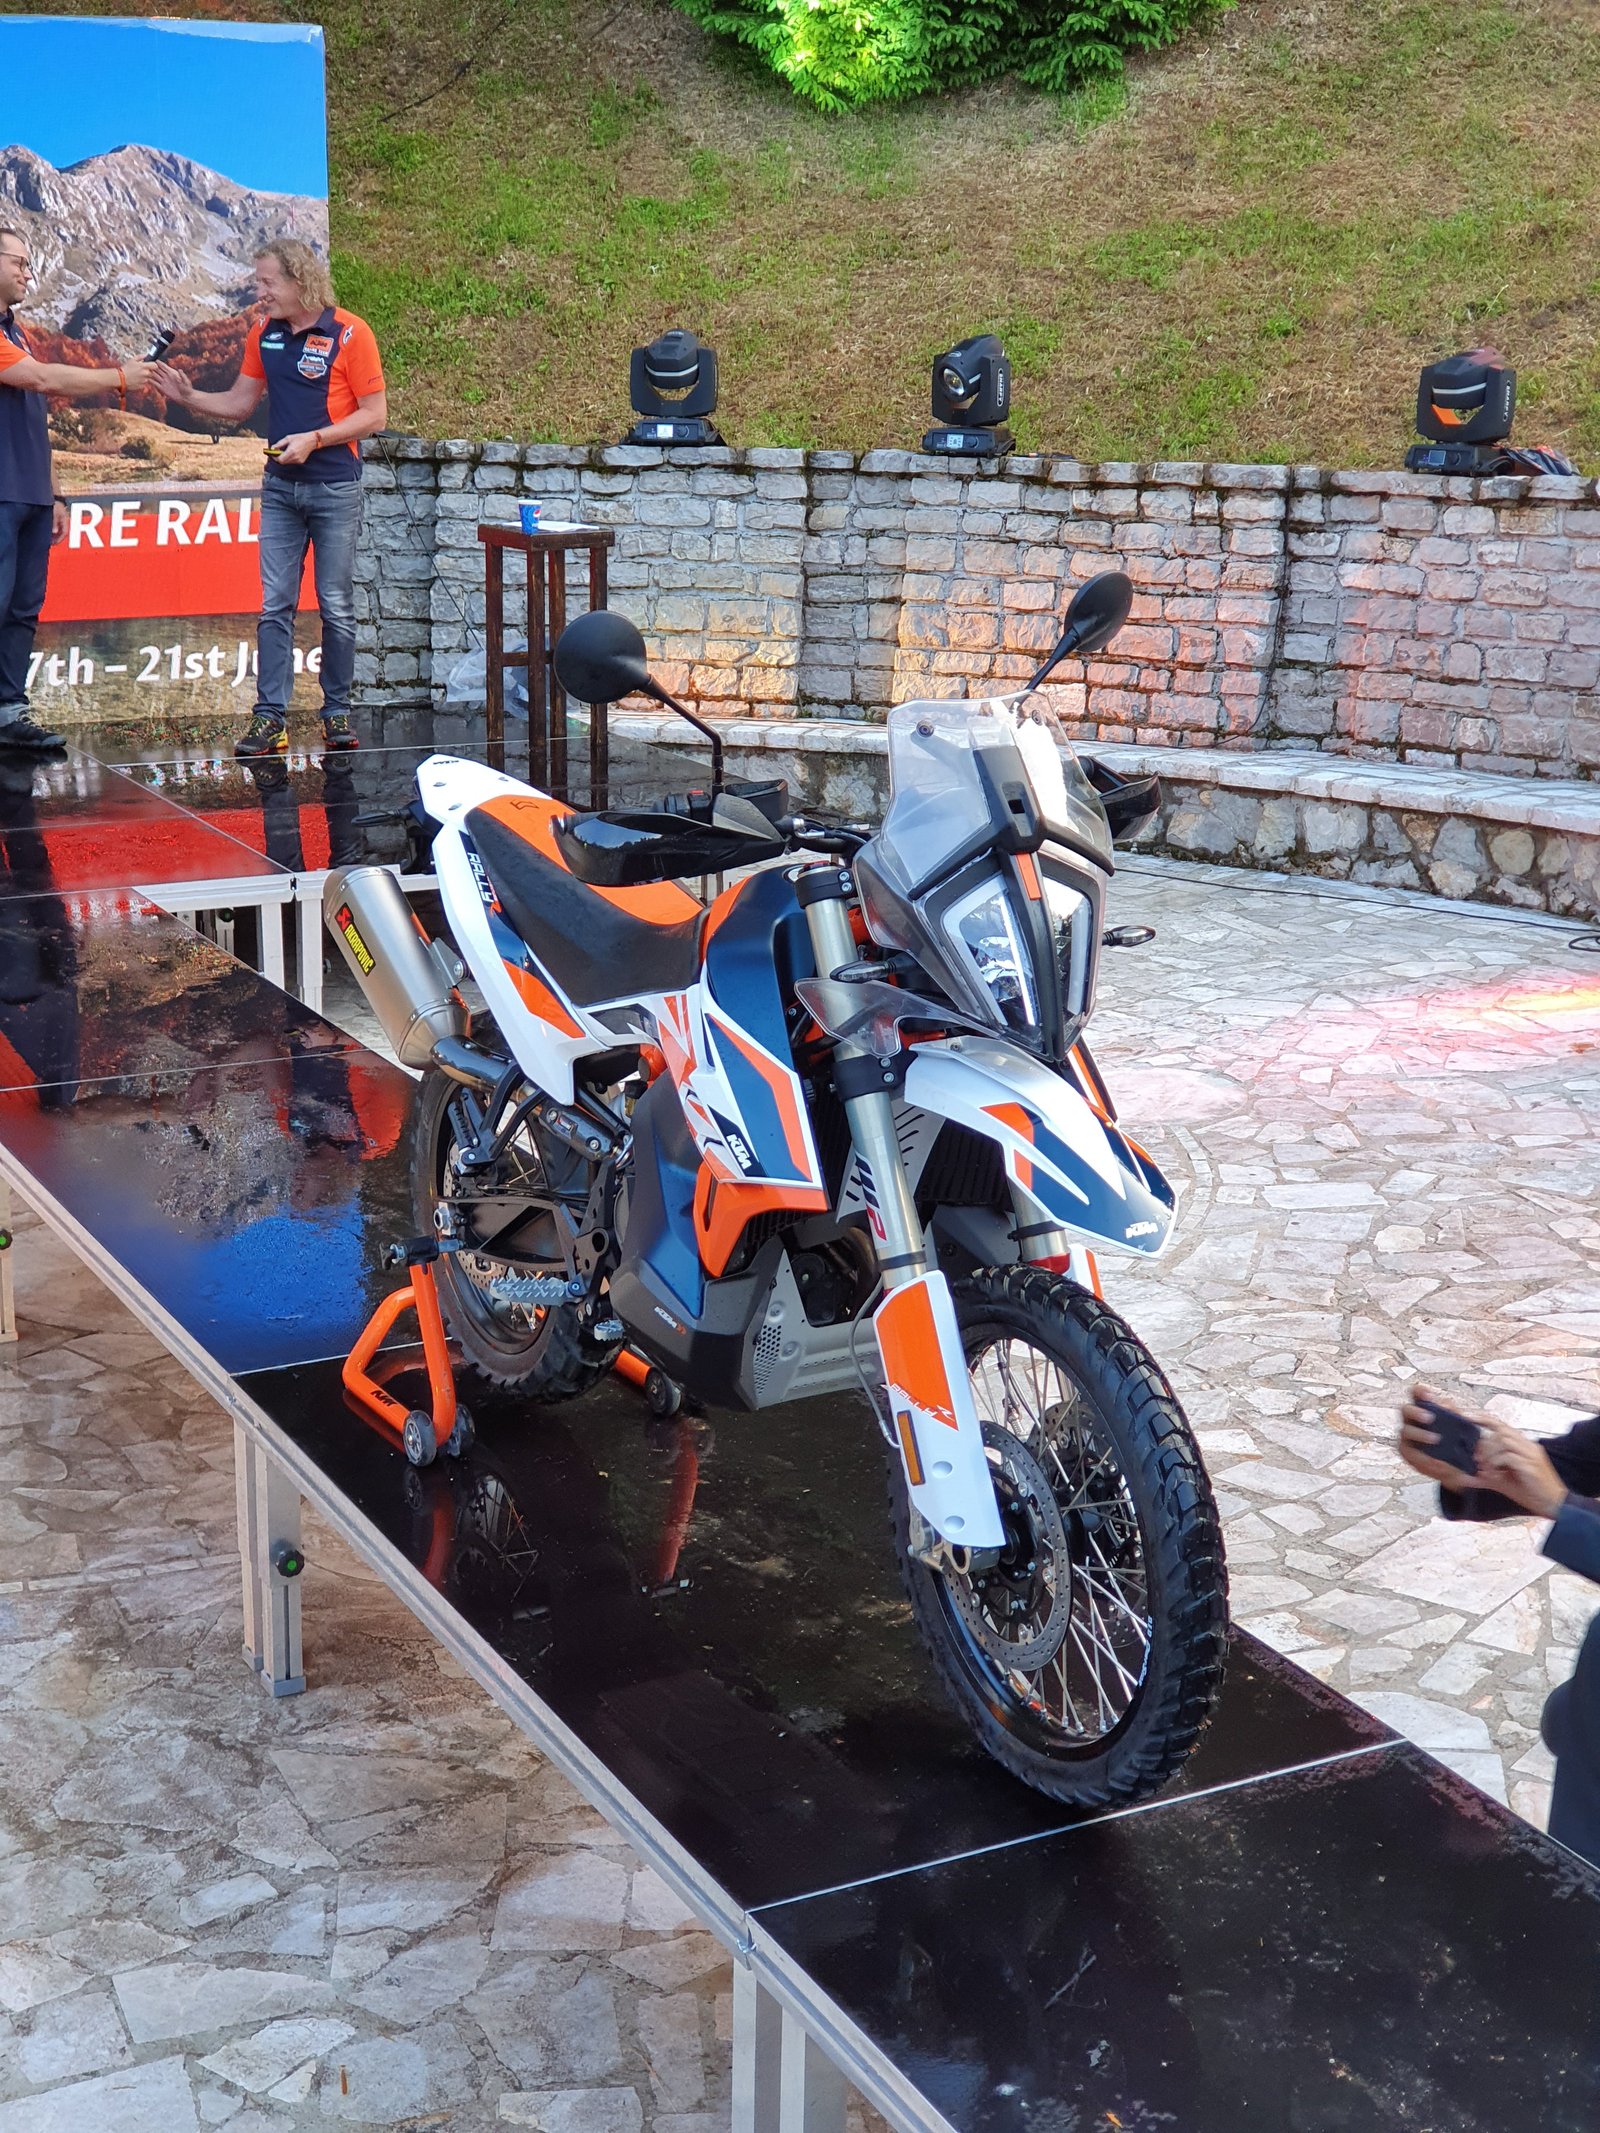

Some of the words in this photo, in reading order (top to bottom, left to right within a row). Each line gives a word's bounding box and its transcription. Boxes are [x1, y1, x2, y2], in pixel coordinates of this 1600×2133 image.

[136, 645, 226, 681] 21st
[467, 852, 494, 903] RALLY
[726, 1133, 753, 1170] KTM
[1125, 1221, 1159, 1239] KTM
[370, 1390, 398, 1406] KTM
[890, 1383, 938, 1417] RALLY
